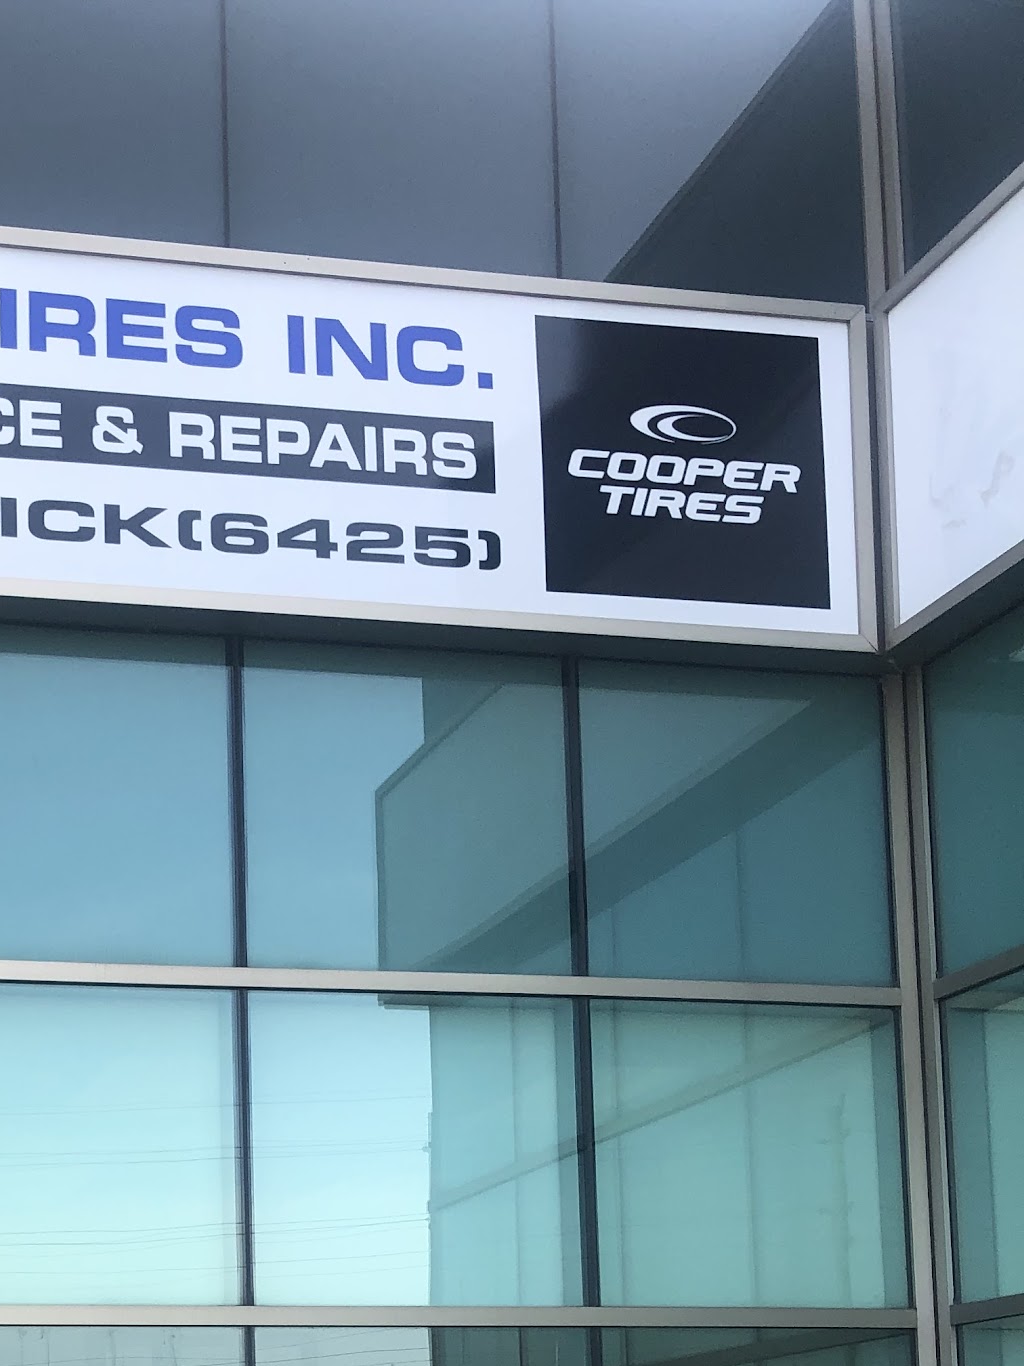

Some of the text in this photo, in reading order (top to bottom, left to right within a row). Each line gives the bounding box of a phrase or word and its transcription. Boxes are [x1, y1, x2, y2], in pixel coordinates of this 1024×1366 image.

[286, 314, 493, 390] INC.
[92, 405, 143, 456] &
[168, 411, 477, 480] REPAIRS
[567, 448, 802, 493] COOPER
[599, 484, 765, 525] TIRES
